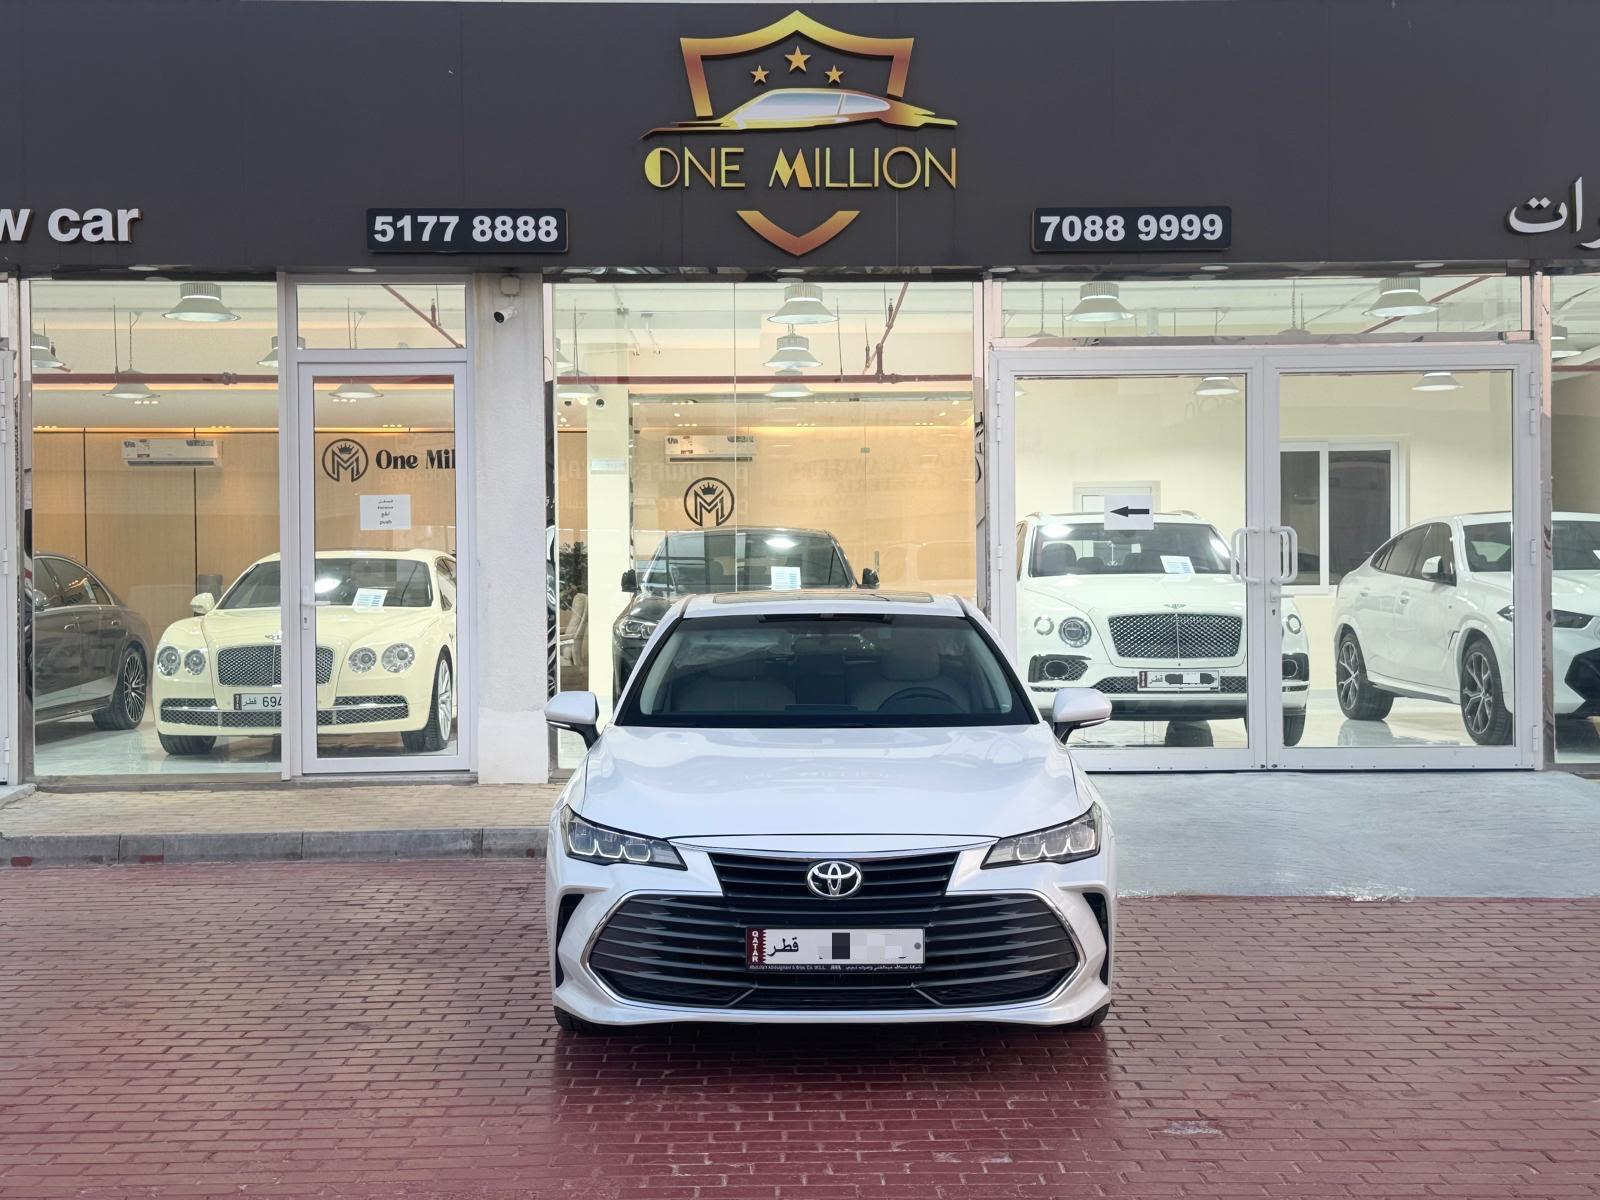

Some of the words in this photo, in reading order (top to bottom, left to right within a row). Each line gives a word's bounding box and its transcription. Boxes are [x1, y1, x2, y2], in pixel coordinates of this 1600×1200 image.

[645, 147, 746, 189] ONE
[768, 147, 957, 189] MILLION
[48, 207, 139, 242] car
[373, 215, 459, 242] 5177
[472, 215, 558, 242] 8888
[1040, 215, 1125, 242] 7088
[1137, 214, 1223, 241] 9999
[375, 449, 419, 469] One
[766, 936, 799, 957] قطر
